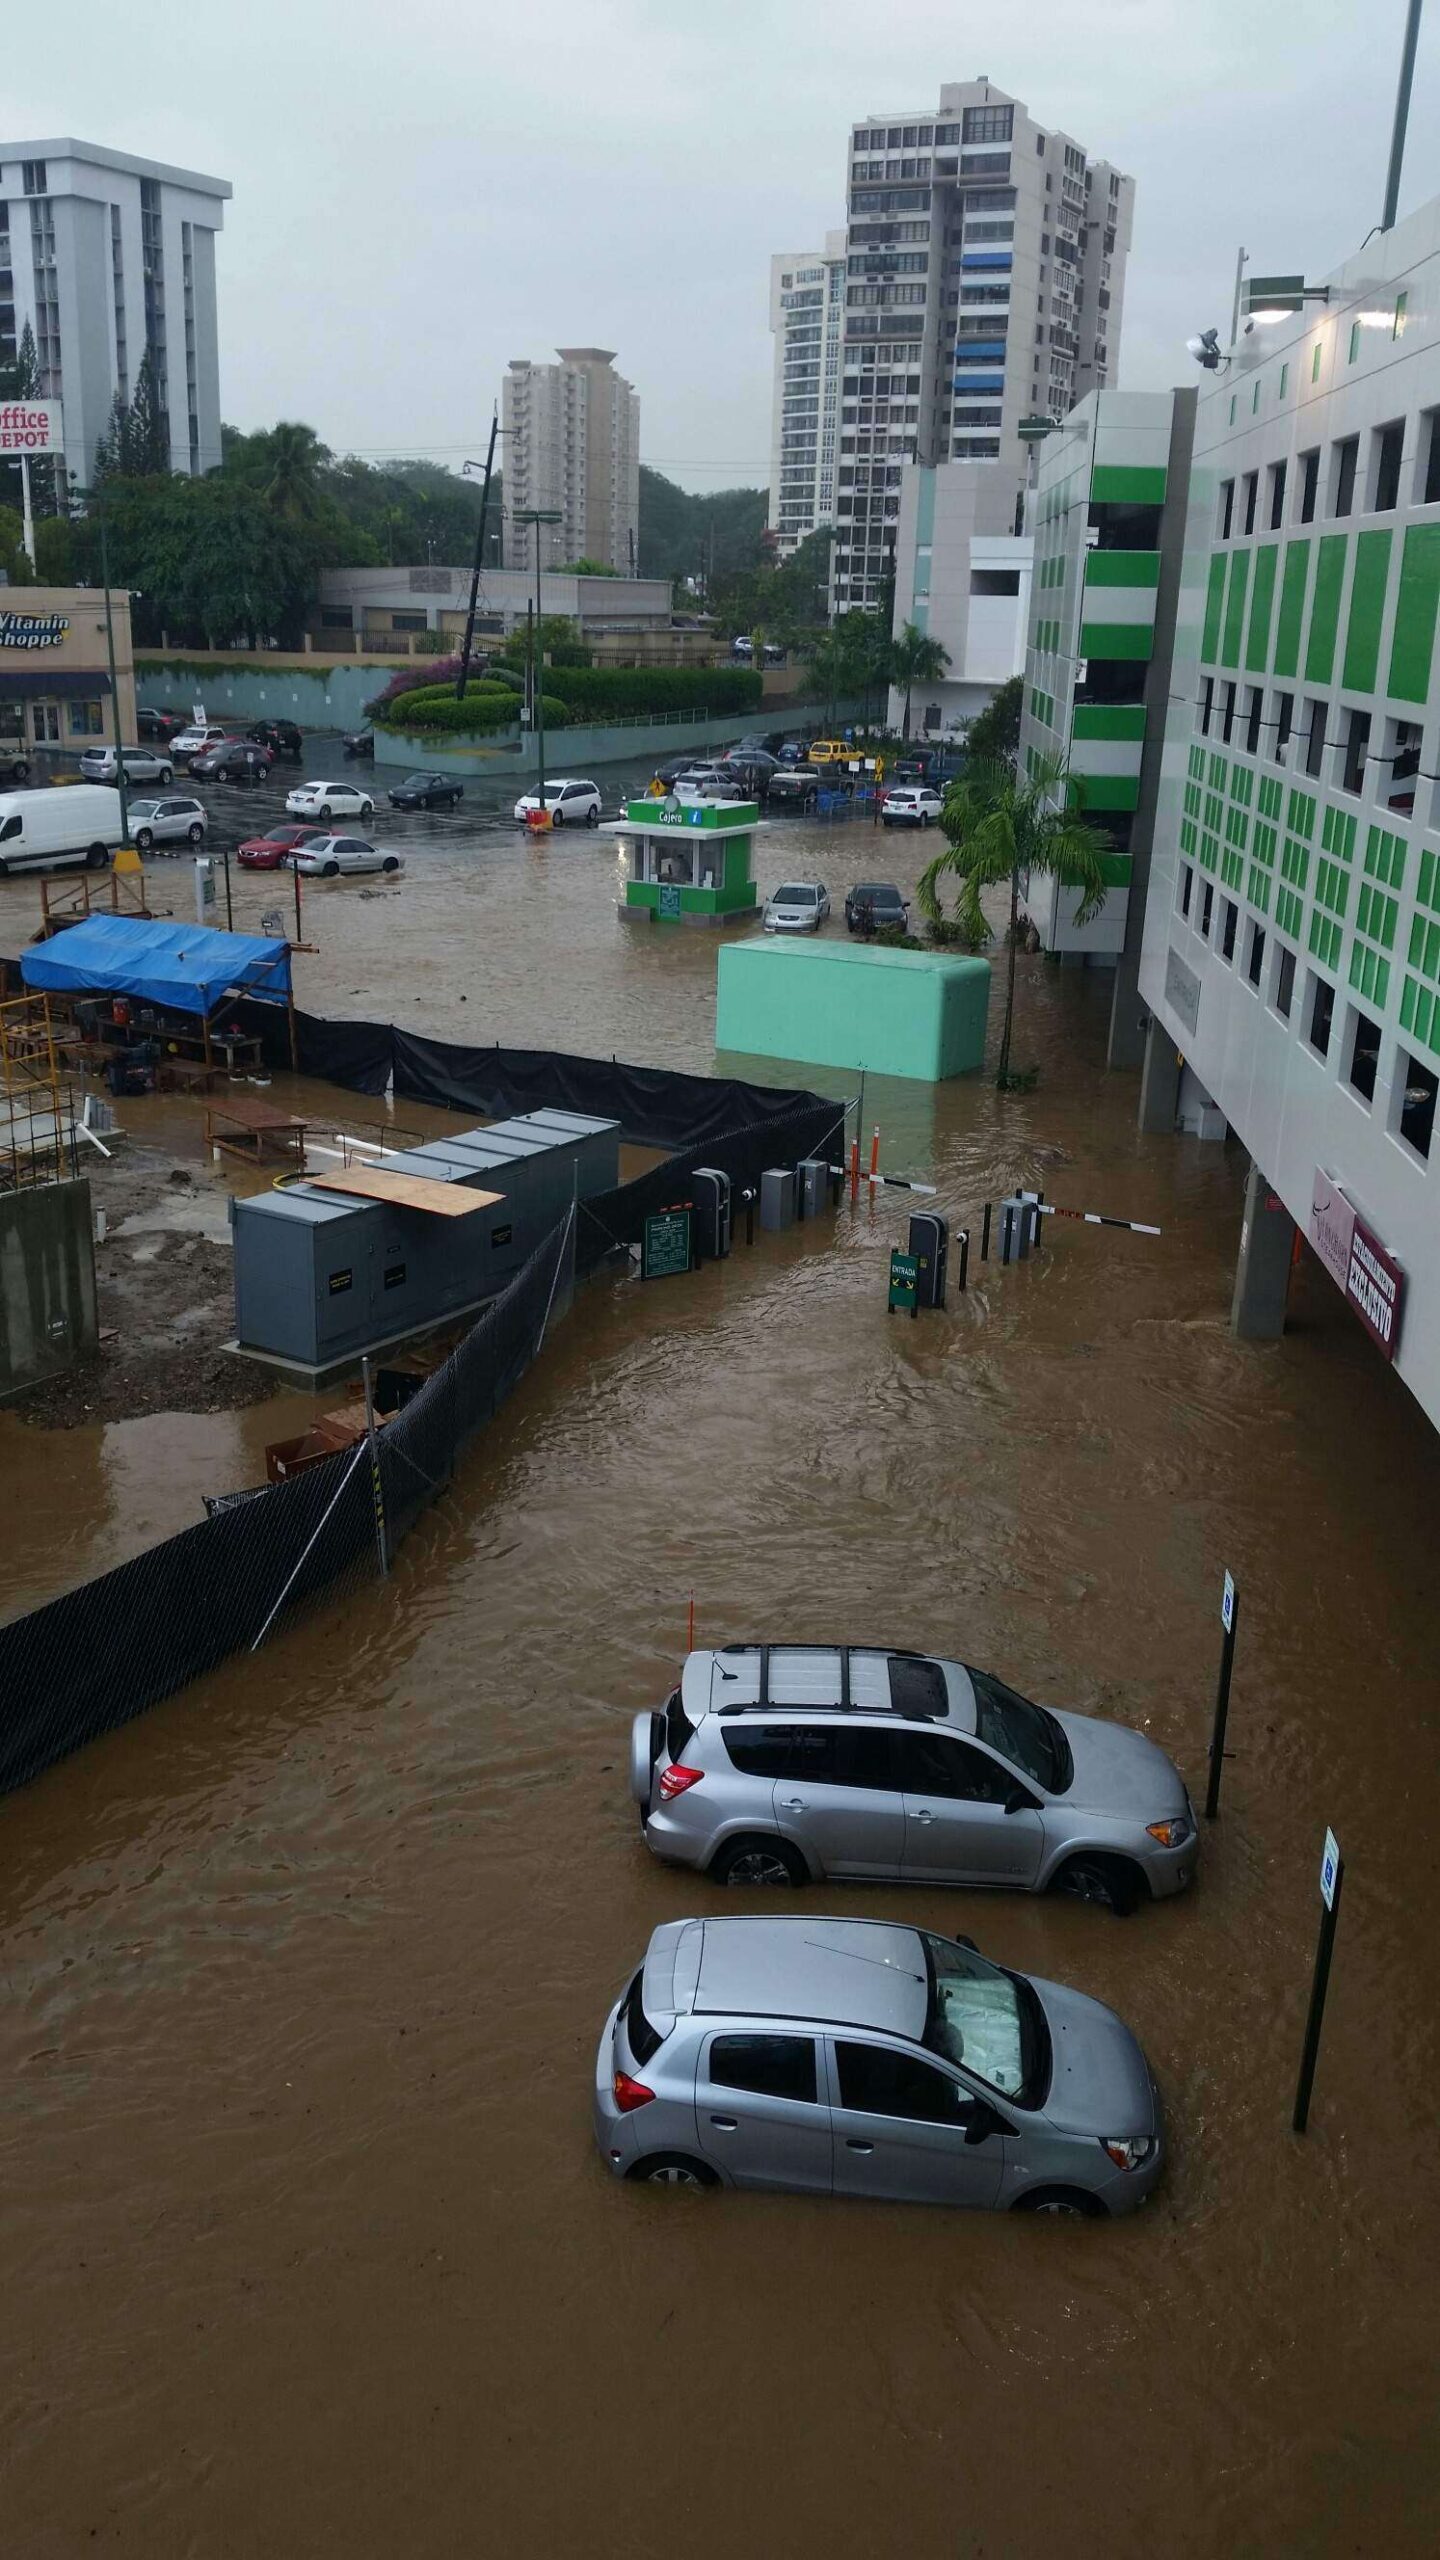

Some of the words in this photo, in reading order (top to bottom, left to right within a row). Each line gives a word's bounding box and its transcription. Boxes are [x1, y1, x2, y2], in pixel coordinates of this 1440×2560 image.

[0, 406, 49, 429] ffice
[0, 431, 49, 447] EPOT
[659, 811, 683, 824] Cajero
[891, 1264, 916, 1277] ENTRADA
[1348, 1255, 1393, 1343] EXCLUSIVO
